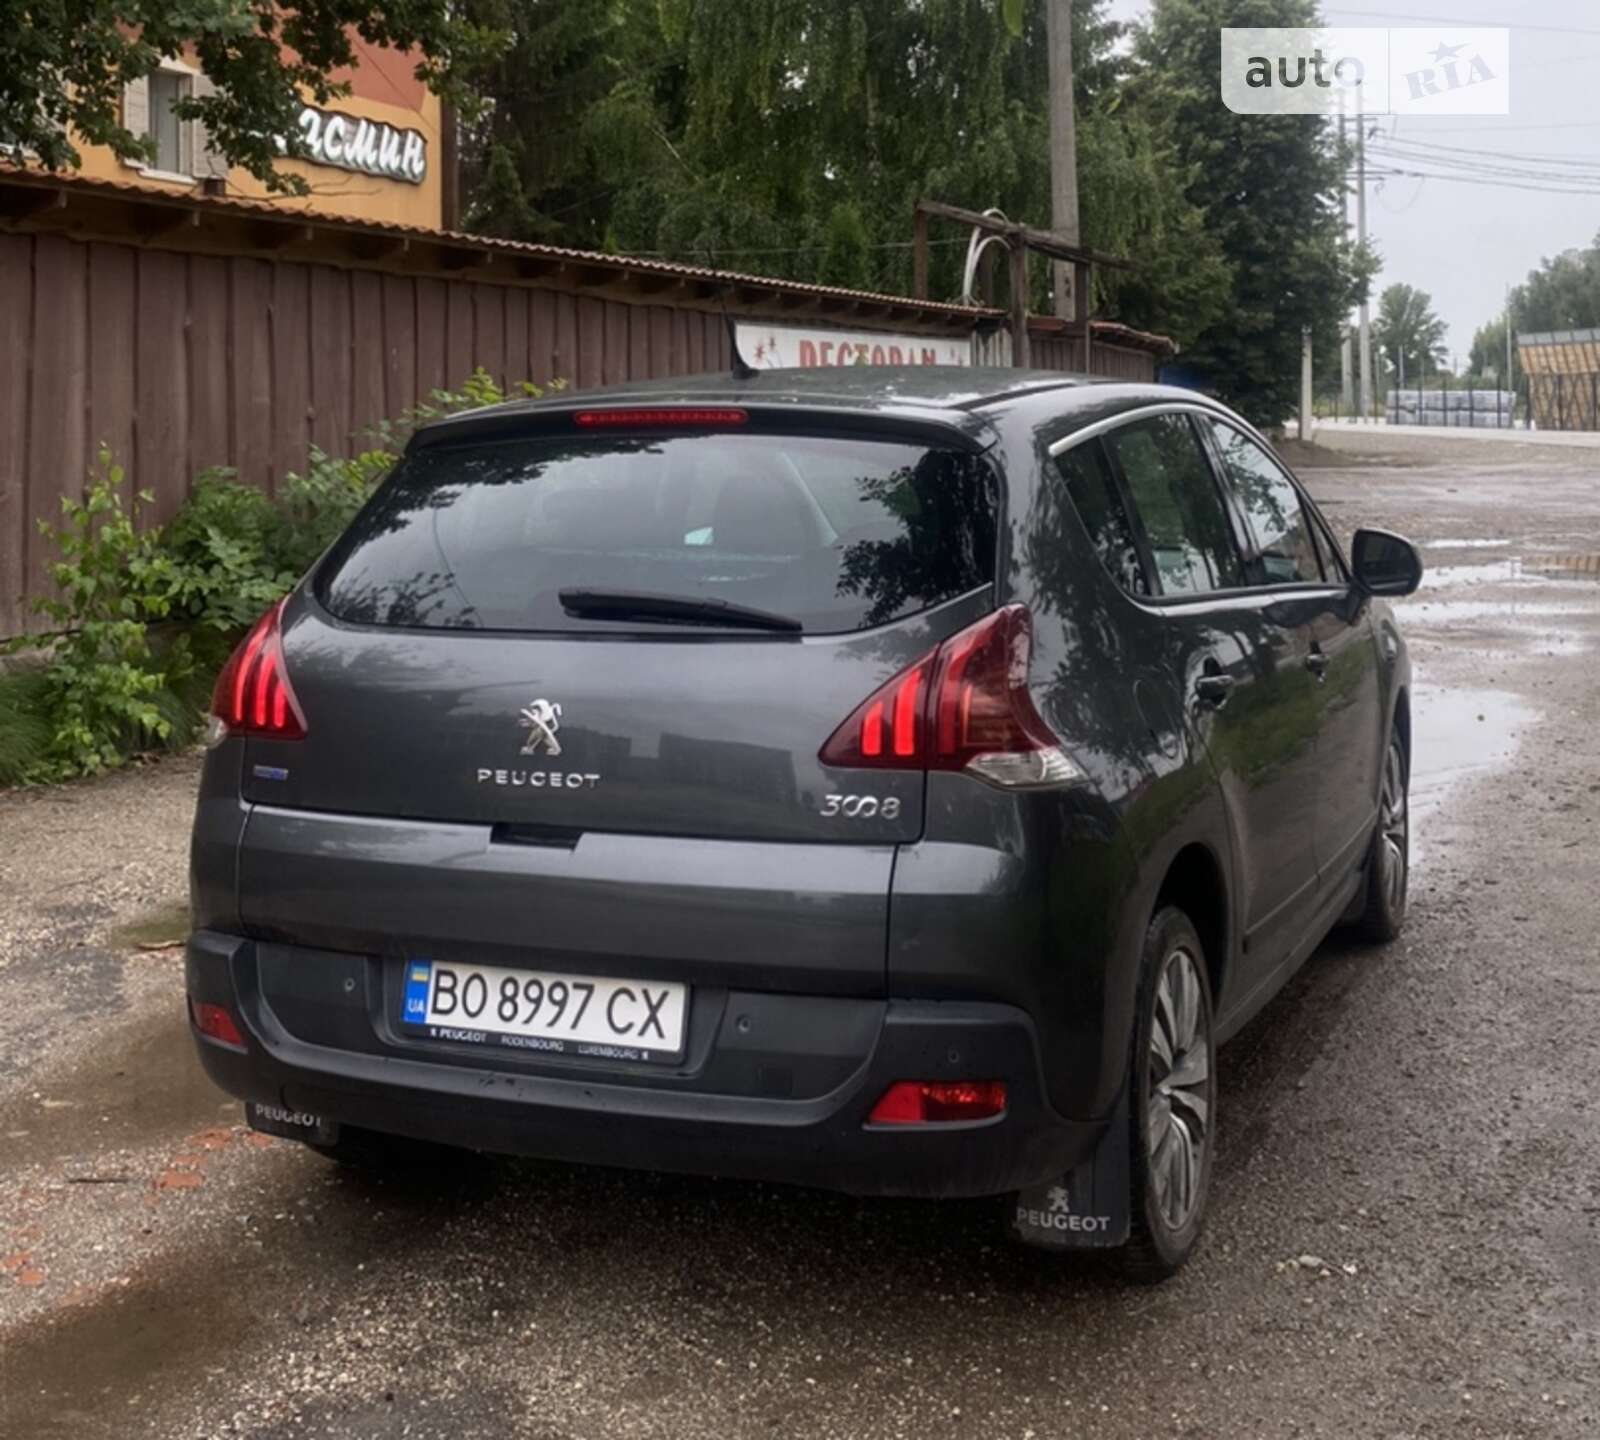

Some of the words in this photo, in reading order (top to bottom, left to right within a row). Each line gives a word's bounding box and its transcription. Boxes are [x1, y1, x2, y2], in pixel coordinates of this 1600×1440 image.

[477, 768, 600, 788] PEUGEOT
[820, 794, 900, 819] 3008
[408, 1000, 424, 1014] UA
[431, 969, 488, 1018] BO
[497, 976, 595, 1030] 8997
[606, 986, 669, 1039] CX
[439, 1028, 487, 1044] PEUGEOT
[1016, 1207, 1111, 1232] PEUGEOT
